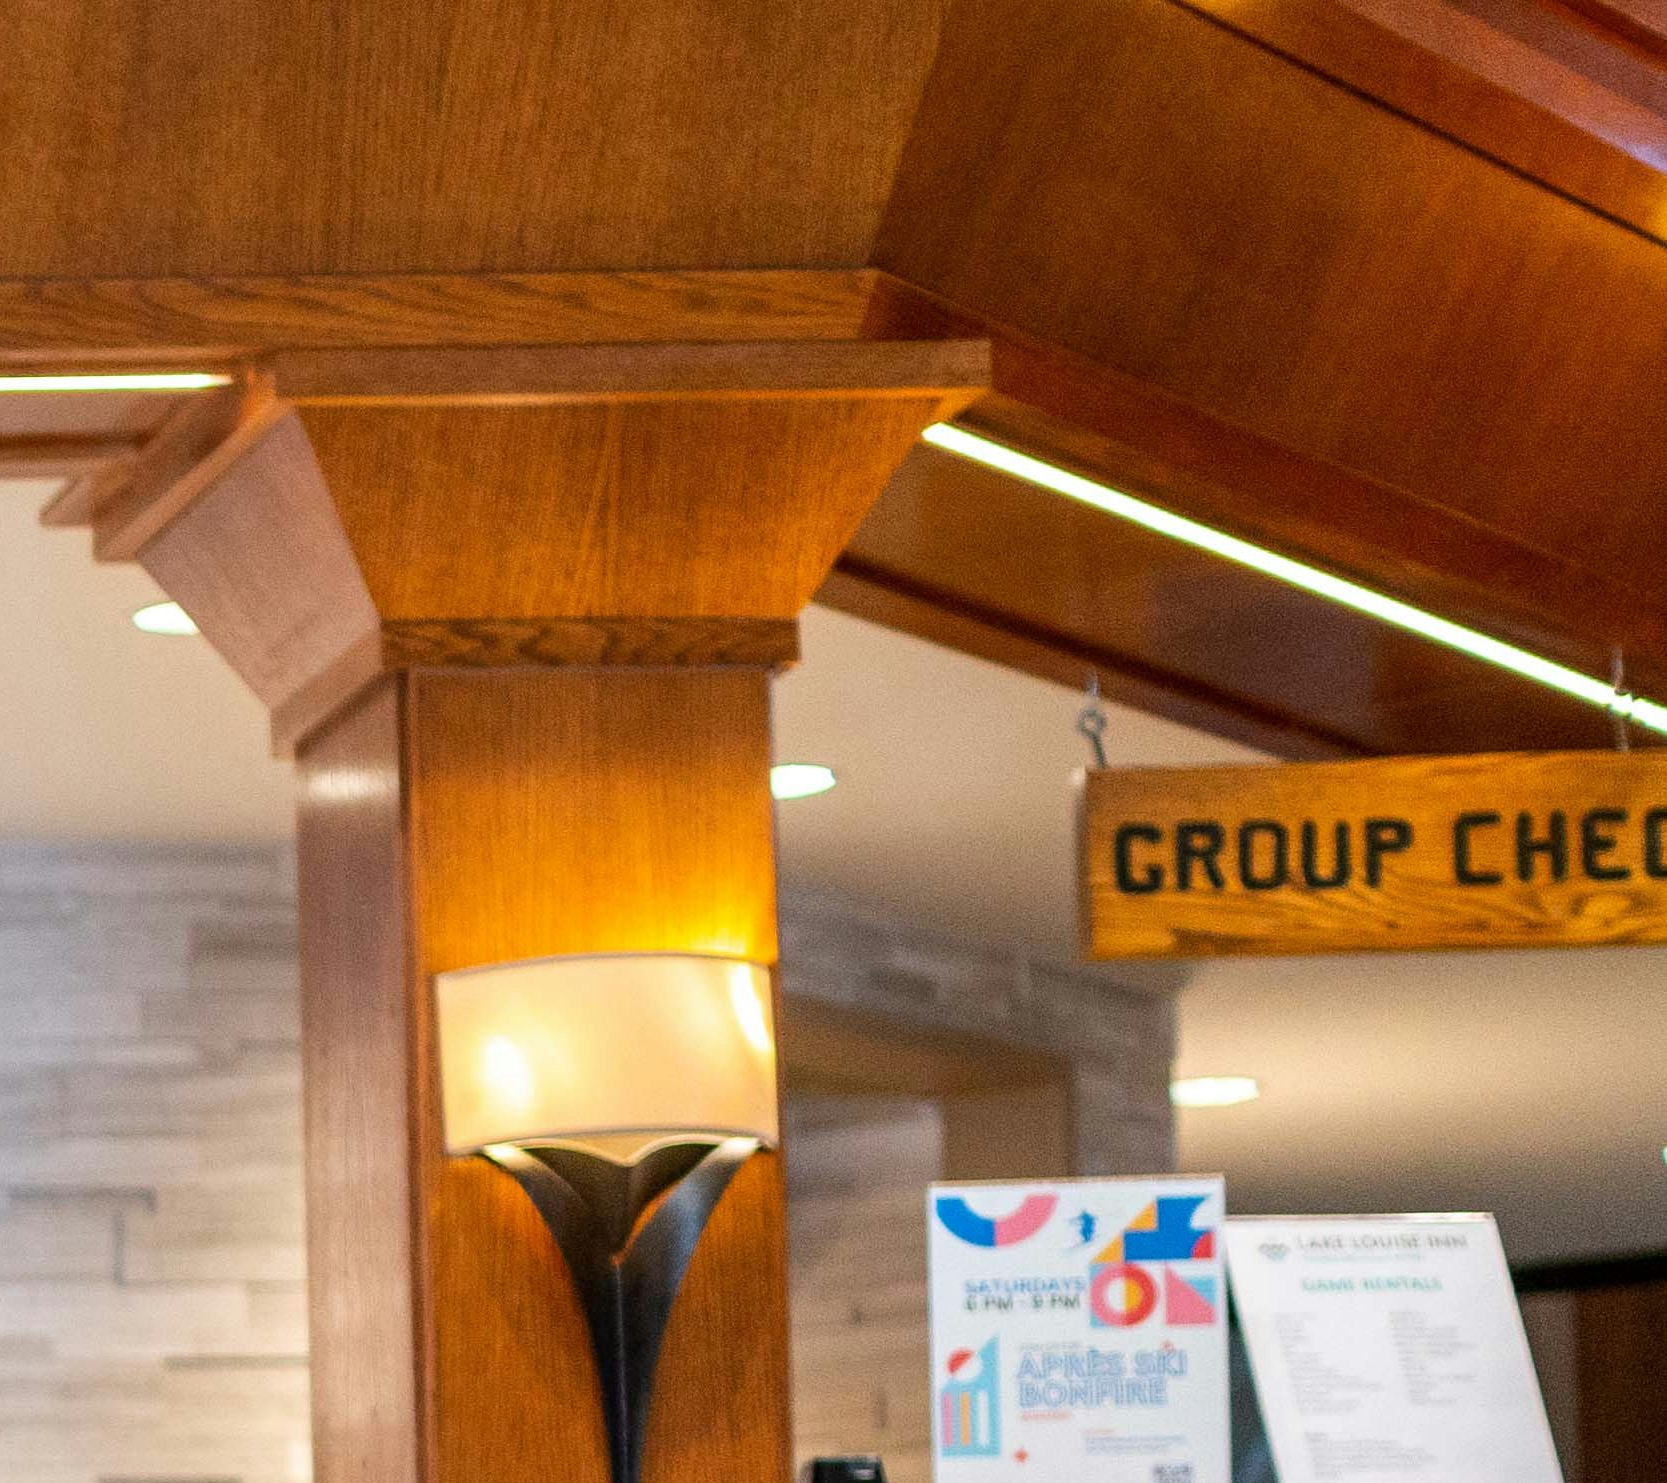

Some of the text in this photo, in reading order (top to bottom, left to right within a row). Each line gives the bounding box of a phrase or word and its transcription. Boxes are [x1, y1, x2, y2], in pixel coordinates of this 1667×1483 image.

[1114, 817, 1415, 894] GROUP
[965, 1277, 1087, 1295] SATURDAYS
[985, 1294, 1013, 1311] PM
[1051, 1293, 1081, 1309] PM
[1017, 1346, 1188, 1379] APRÈS SKI
[1019, 1377, 1168, 1409] BONFIRE
